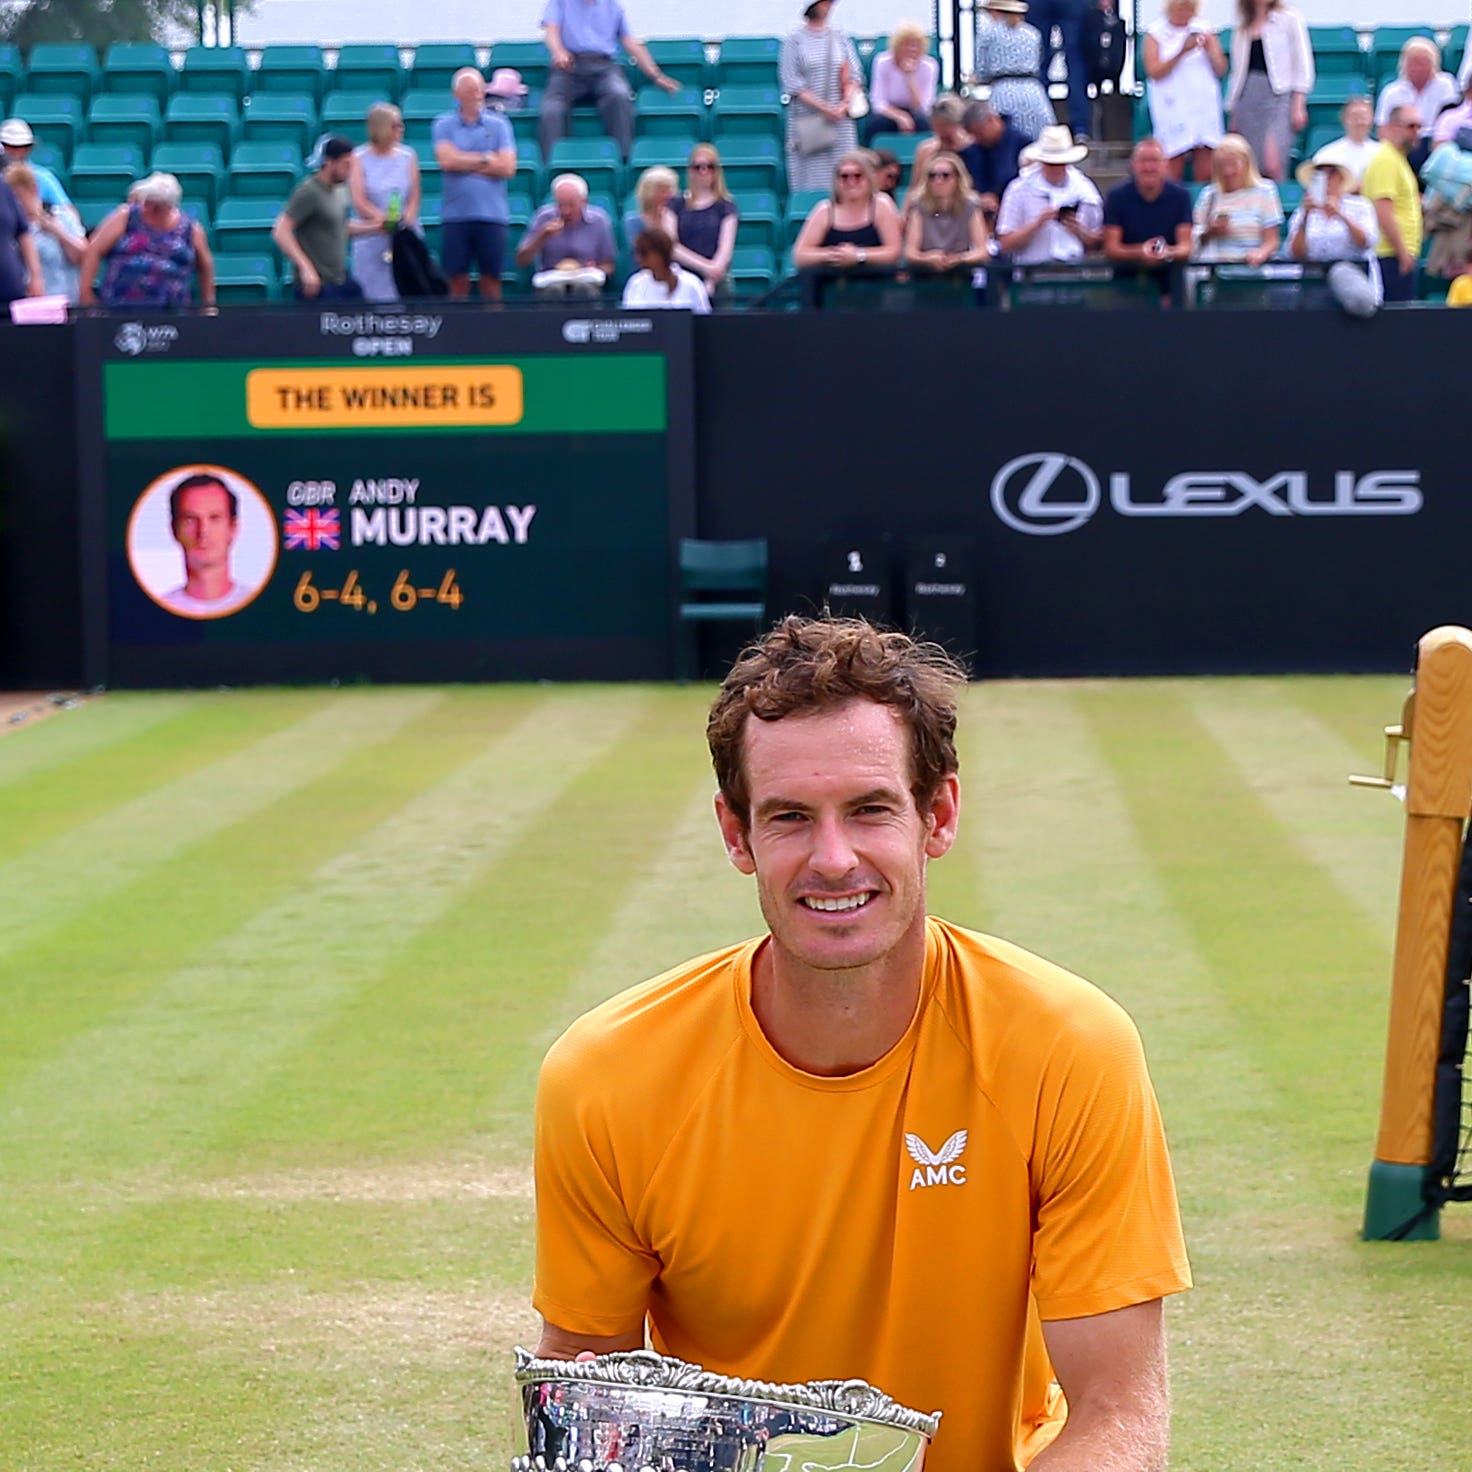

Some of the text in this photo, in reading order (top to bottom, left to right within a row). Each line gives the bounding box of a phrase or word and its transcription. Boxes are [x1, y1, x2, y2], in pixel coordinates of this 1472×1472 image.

[321, 312, 442, 338] Rothesay
[352, 337, 413, 356] OPEN
[278, 383, 495, 409] THE WINNER IS
[349, 478, 420, 504] ANDY
[1109, 470, 1424, 516] LEXUS
[351, 504, 537, 546] MURRAY
[293, 568, 464, 614] 6-4, 6-4
[909, 1164, 967, 1190] AMC
